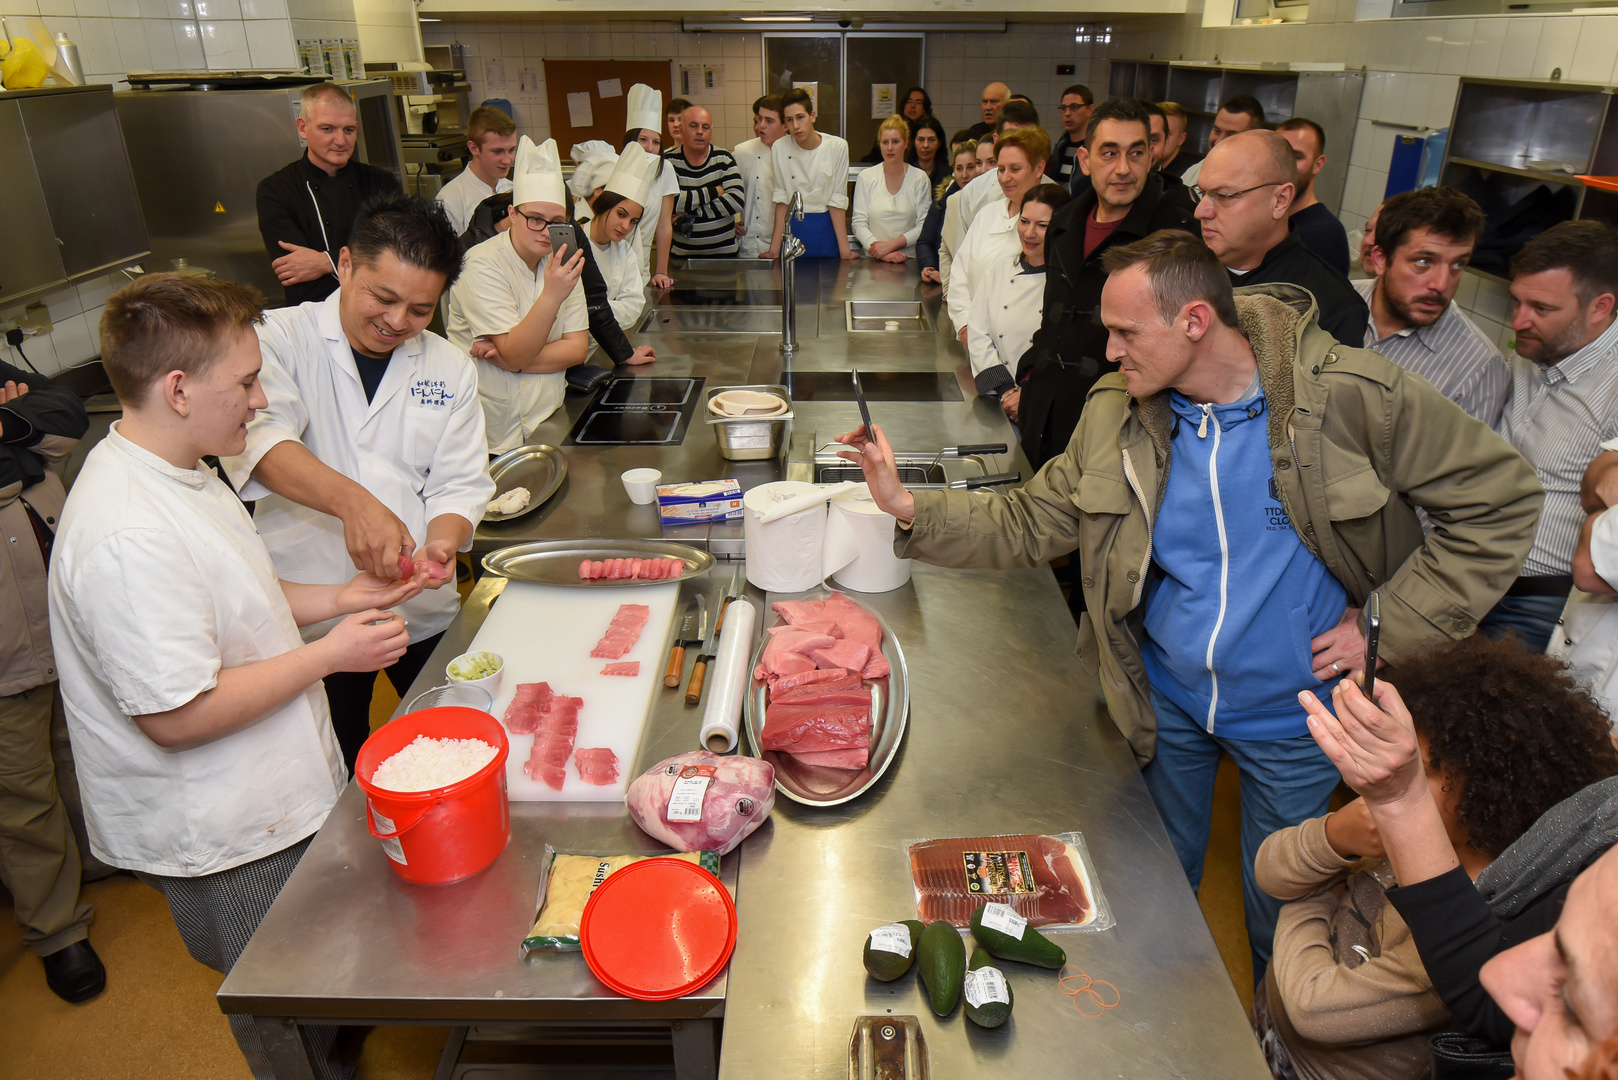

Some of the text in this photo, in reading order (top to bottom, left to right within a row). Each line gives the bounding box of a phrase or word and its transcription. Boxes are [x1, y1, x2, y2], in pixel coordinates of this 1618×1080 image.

[411, 388, 454, 399] にんにん
[592, 862, 610, 886] Sushi
